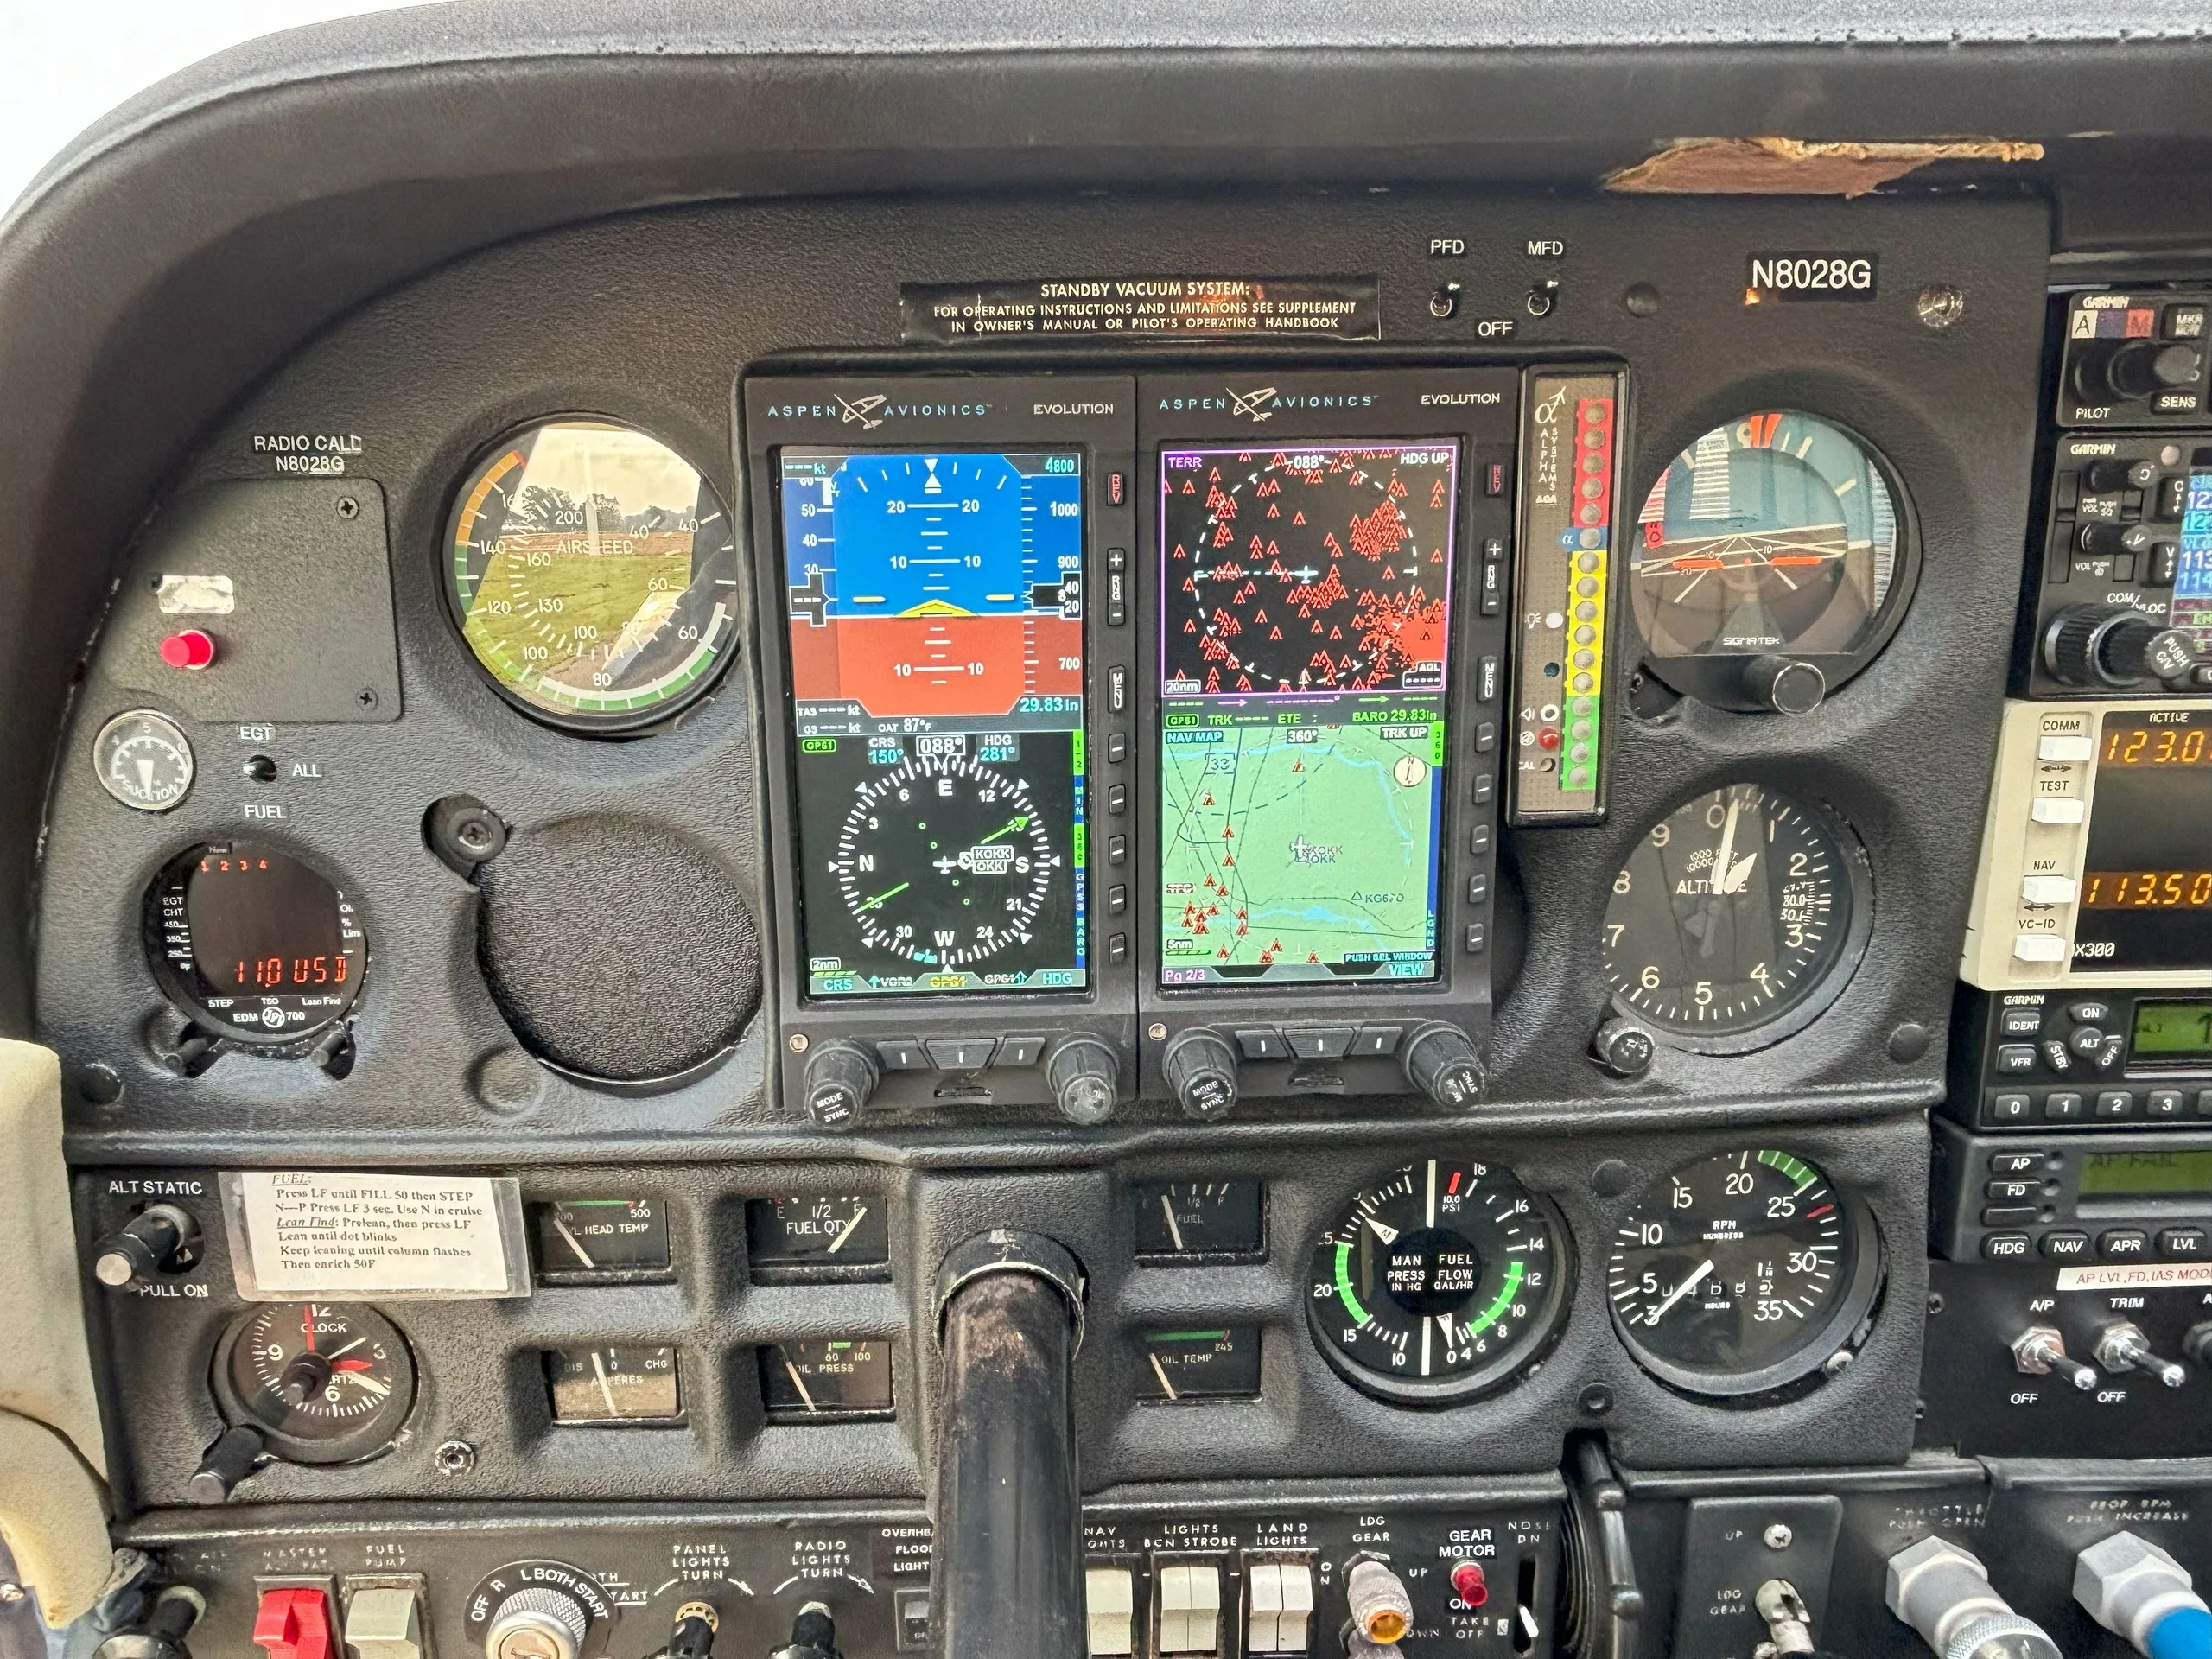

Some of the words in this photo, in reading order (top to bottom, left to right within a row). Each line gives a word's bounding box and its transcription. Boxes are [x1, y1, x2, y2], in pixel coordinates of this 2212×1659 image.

[1431, 240, 1464, 255] PFD
[1528, 241, 1563, 256] MFD
[1752, 258, 1872, 289] N8028G
[1041, 283, 1110, 297] STANDBY
[1116, 283, 1181, 296] VACUUM
[1188, 281, 1249, 296] SYSTEM:
[934, 306, 961, 317] FOR
[963, 304, 1035, 318] OPERATING
[1040, 302, 1132, 315] INSTRUCTIONS
[1137, 302, 1165, 315] AND
[1170, 302, 1247, 315] LIMITATIONS
[1252, 302, 1273, 314] SEE
[1278, 302, 1356, 314] SUPPLEMENT
[951, 321, 965, 332] IN
[974, 319, 1033, 332] OWNER'S
[1044, 318, 1098, 331] MANUAL
[1105, 318, 1122, 329] OR
[1132, 318, 1178, 329] PILOT'S
[1185, 317, 1256, 329] OPERATING
[1266, 317, 1338, 329] HANDBOOK
[1478, 322, 1512, 335] OFF
[1160, 398, 1225, 410] ASPEN
[1272, 397, 1371, 408] AVIONICS
[1421, 394, 1500, 404] EVOLUTION
[2161, 397, 2196, 408] SENS
[768, 404, 836, 416] ASPEN
[884, 404, 985, 416] AVIONICS
[1033, 404, 1114, 415] EVOLUTION
[2076, 408, 2110, 419] PILOT
[254, 435, 310, 451] RADIO
[2070, 444, 2115, 454] GARMIN
[1401, 454, 1426, 464] HDG
[1428, 453, 1449, 464] UP
[1539, 428, 1548, 482] ALPHA
[276, 456, 344, 471] N8028G
[1045, 459, 1074, 472] 4800
[1168, 457, 1201, 467] TERR
[802, 504, 815, 517] 50
[1050, 503, 1077, 516] 1000
[556, 511, 583, 524] 200
[480, 542, 506, 555] 140
[1058, 556, 1078, 567] 900
[539, 599, 563, 612] 130
[797, 707, 817, 716] TAS
[1208, 713, 1232, 725] TRK
[1278, 713, 1301, 723] ETE
[1353, 711, 1387, 721] BARO
[2150, 713, 2189, 722] ACTIVE
[878, 723, 898, 733] OAT
[2043, 720, 2080, 730] COMM
[240, 726, 271, 741] EGT
[1382, 726, 1407, 738] TRK
[1409, 726, 1427, 737] UP
[869, 737, 896, 748] CRS
[985, 735, 1012, 745] HDG
[292, 764, 321, 777] ALL
[122, 780, 180, 800] SUCTION
[2040, 781, 2069, 791] TEST
[245, 805, 286, 818] FUEL
[2034, 861, 2056, 869] NAV
[2019, 919, 2055, 929] VC-ID
[1165, 970, 1182, 982] Pg
[1187, 969, 1205, 981] 2/3
[1390, 964, 1424, 976] VIEW
[208, 999, 233, 1007] STEP
[2004, 995, 2044, 1005] GARMIN
[233, 1013, 257, 1021] EDM
[286, 1012, 305, 1020] 700
[2082, 1007, 2099, 1018] ON
[2010, 1020, 2038, 1030] IDENT
[2080, 1039, 2099, 1048] ALT
[2011, 1058, 2031, 1066] VFR
[1474, 1164, 1486, 1174] 18
[2011, 1158, 2030, 1170] AP
[109, 1181, 140, 1194] ALT
[144, 1181, 202, 1194] STATIC
[2007, 1185, 2025, 1196] FD
[276, 1189, 307, 1198] Press
[332, 1189, 357, 1198] until
[361, 1191, 391, 1199] FILL
[412, 1191, 435, 1200] then
[439, 1192, 473, 1201] STEP
[310, 1204, 340, 1212] Press
[344, 1204, 359, 1212] LF
[397, 1205, 417, 1213] Use
[435, 1205, 445, 1214] in
[448, 1207, 482, 1216] cruise
[1516, 1201, 1529, 1212] 16
[1768, 1196, 1796, 1217] 25
[277, 1217, 304, 1228] Lean
[422, 1221, 450, 1230] press
[454, 1220, 471, 1229] LF
[585, 1224, 613, 1234] HEAD
[618, 1224, 649, 1233] TEMP
[786, 1222, 822, 1235] FUEL
[824, 1221, 851, 1235] QTY
[1713, 1220, 1736, 1230] RPM
[340, 1232, 359, 1241] dot
[363, 1232, 397, 1242] blinks
[1994, 1243, 2024, 1254] HDG
[2054, 1241, 2083, 1252] NAV
[2111, 1240, 2140, 1251] APR
[2173, 1239, 2196, 1249] LVL
[281, 1246, 310, 1256] Keep
[314, 1246, 354, 1255] leaning
[388, 1247, 429, 1255] column
[433, 1248, 471, 1256] flashes
[281, 1260, 309, 1268] Then
[315, 1260, 350, 1268] enrich
[1393, 1255, 1421, 1265] MAN
[1439, 1255, 1472, 1265] FUEL
[1388, 1271, 1425, 1281] PRESS
[1439, 1270, 1473, 1280] FLOW
[2077, 1274, 2094, 1284] AP
[140, 1284, 179, 1298] PULL
[184, 1284, 208, 1297] ON
[1434, 1281, 1473, 1290] GAL/HR
[2031, 1300, 2054, 1312] A/P
[2111, 1298, 2144, 1308] TRIM
[1754, 1300, 1783, 1320] 35
[301, 1323, 346, 1332] CLOCK
[1185, 1353, 1212, 1363] TEMP
[819, 1363, 854, 1373] PRESS
[2011, 1393, 2038, 1405] OFF
[2097, 1391, 2126, 1402] OFF
[1360, 1517, 1385, 1527] LDG
[1164, 1525, 1218, 1534] LIGHTS
[1257, 1524, 1308, 1533] LAND
[1352, 1533, 1389, 1542] GEAR
[1450, 1529, 1491, 1542] GEAR
[796, 1541, 846, 1550] RADIO
[1145, 1539, 1177, 1548] BCN
[1184, 1537, 1237, 1547] STROBE
[1256, 1537, 1308, 1546] LIGHTS
[674, 1545, 726, 1554] PANEL
[1440, 1545, 1496, 1557] MOTOR
[672, 1557, 729, 1567] LIGHTS
[792, 1555, 850, 1565] LIGHTS
[682, 1571, 723, 1580] TURN
[802, 1568, 843, 1577] TURN
[472, 1599, 487, 1621] OFF
[491, 1580, 505, 1593] R
[520, 1569, 531, 1581] L
[534, 1568, 575, 1589] BOTH
[575, 1583, 608, 1619] START
